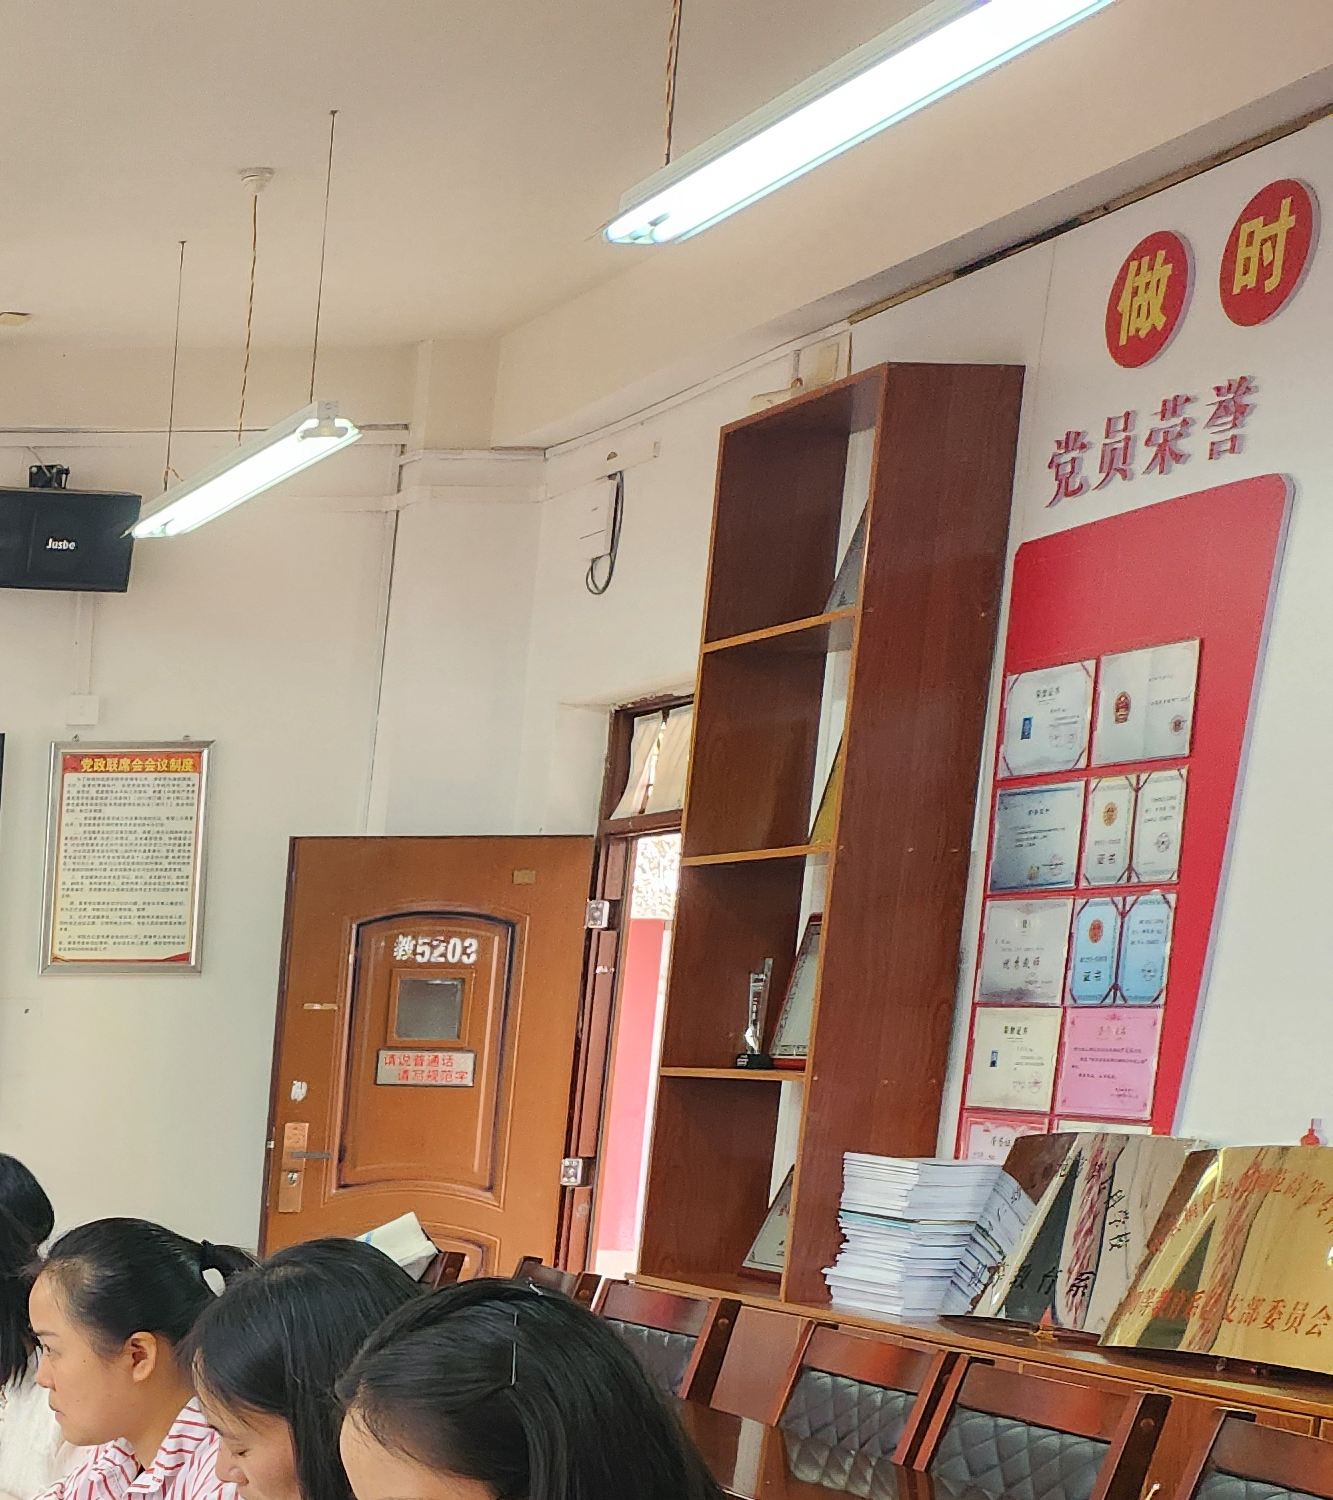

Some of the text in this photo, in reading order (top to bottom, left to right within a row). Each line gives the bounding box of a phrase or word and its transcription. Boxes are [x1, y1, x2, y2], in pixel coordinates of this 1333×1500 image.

[1045, 376, 1253, 508] 党员荣誉
[80, 757, 195, 772] 党政联席会会议制度
[393, 934, 479, 964] 教5203
[384, 1053, 454, 1068] 请说普通话
[397, 1069, 469, 1083] 请写规范字
